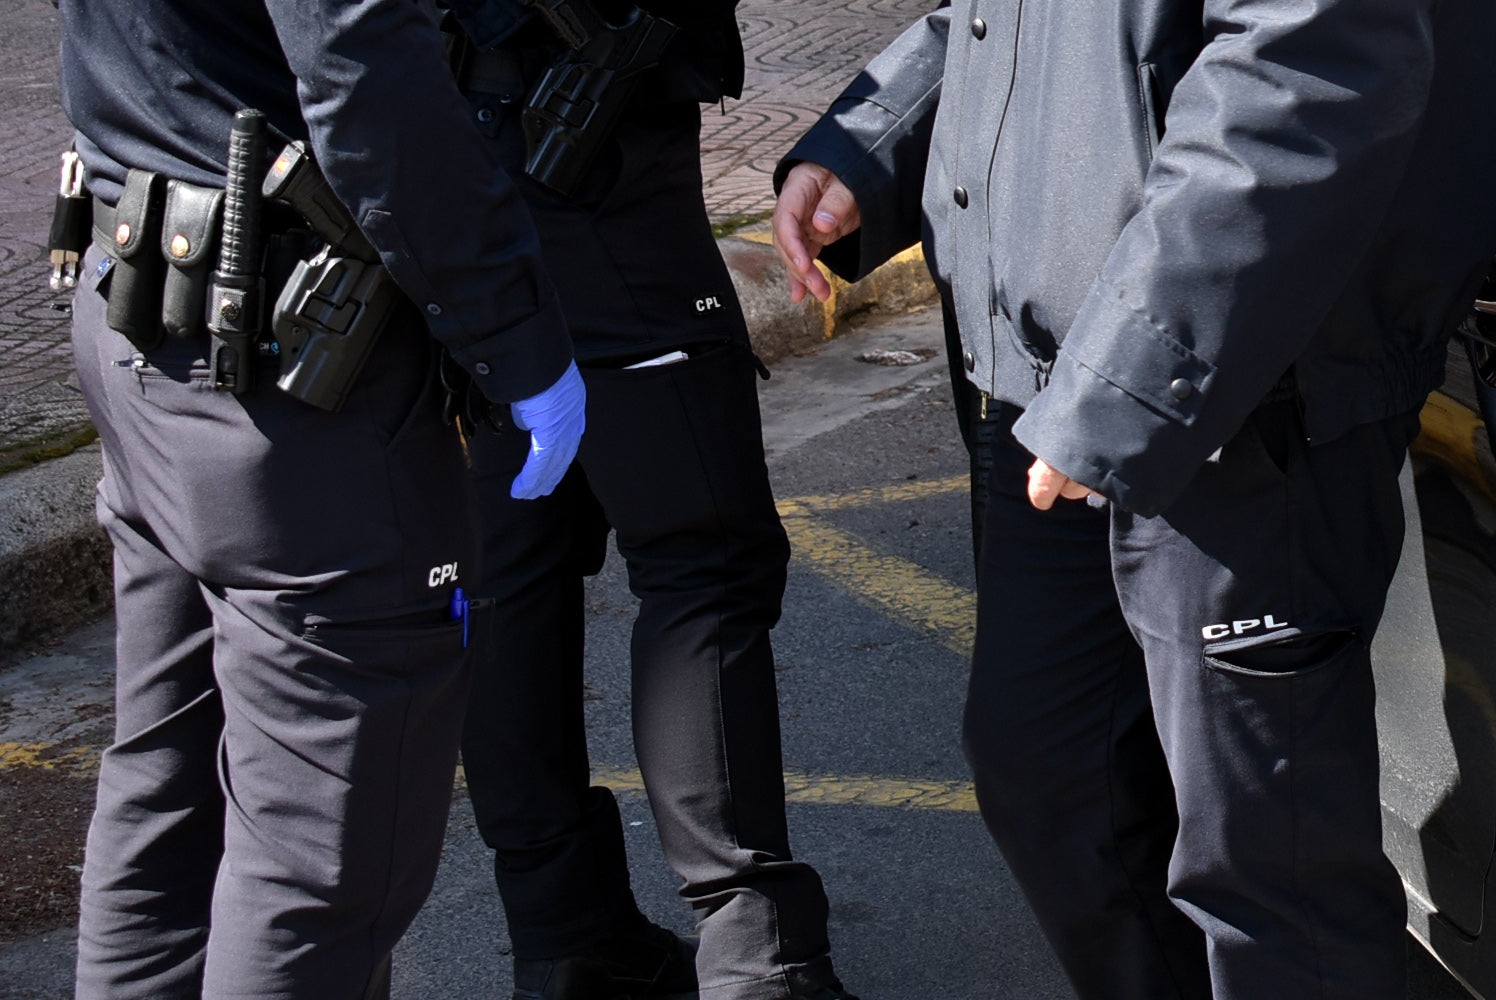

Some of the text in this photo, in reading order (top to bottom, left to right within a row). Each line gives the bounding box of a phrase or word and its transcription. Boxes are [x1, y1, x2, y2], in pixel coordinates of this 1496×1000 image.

[696, 296, 721, 311] CPL
[429, 561, 458, 587] CPL
[1202, 614, 1288, 639] CPL
